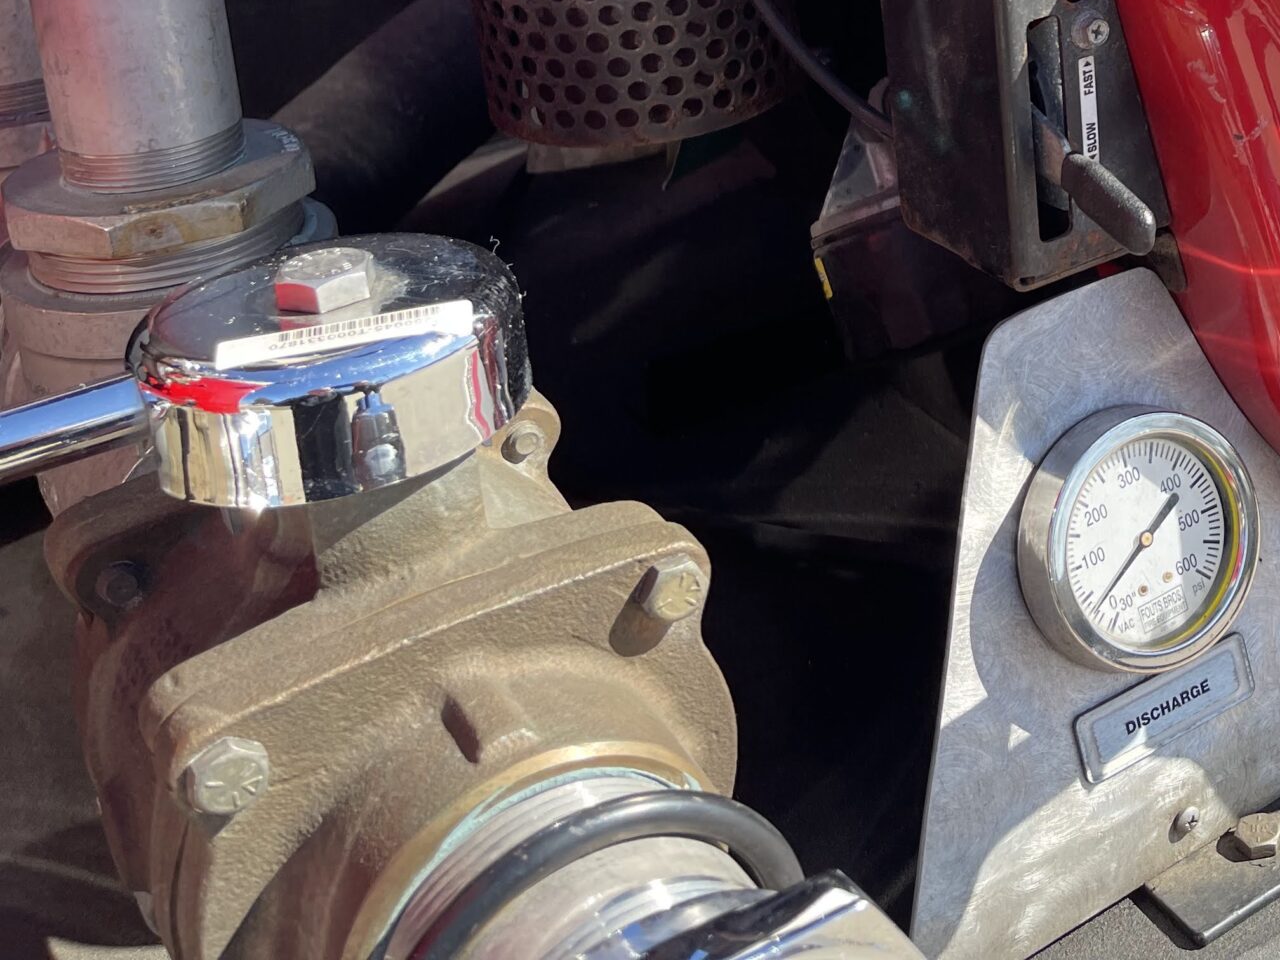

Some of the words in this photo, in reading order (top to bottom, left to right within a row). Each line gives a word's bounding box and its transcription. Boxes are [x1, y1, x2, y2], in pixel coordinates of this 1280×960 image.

[1082, 69, 1094, 96] FAST
[1085, 122, 1098, 153] SLOW
[1117, 466, 1140, 489] 300
[1160, 473, 1181, 495] 400
[1084, 503, 1108, 527] 200
[1178, 509, 1200, 532] 500
[1081, 546, 1105, 570] 100
[1175, 553, 1198, 576] 600
[1192, 580, 1206, 597] psi
[1108, 594, 1118, 610] 0
[1140, 600, 1164, 620] FOUTS
[1118, 617, 1136, 634] VAC
[1124, 678, 1211, 735] DISCHARGE
